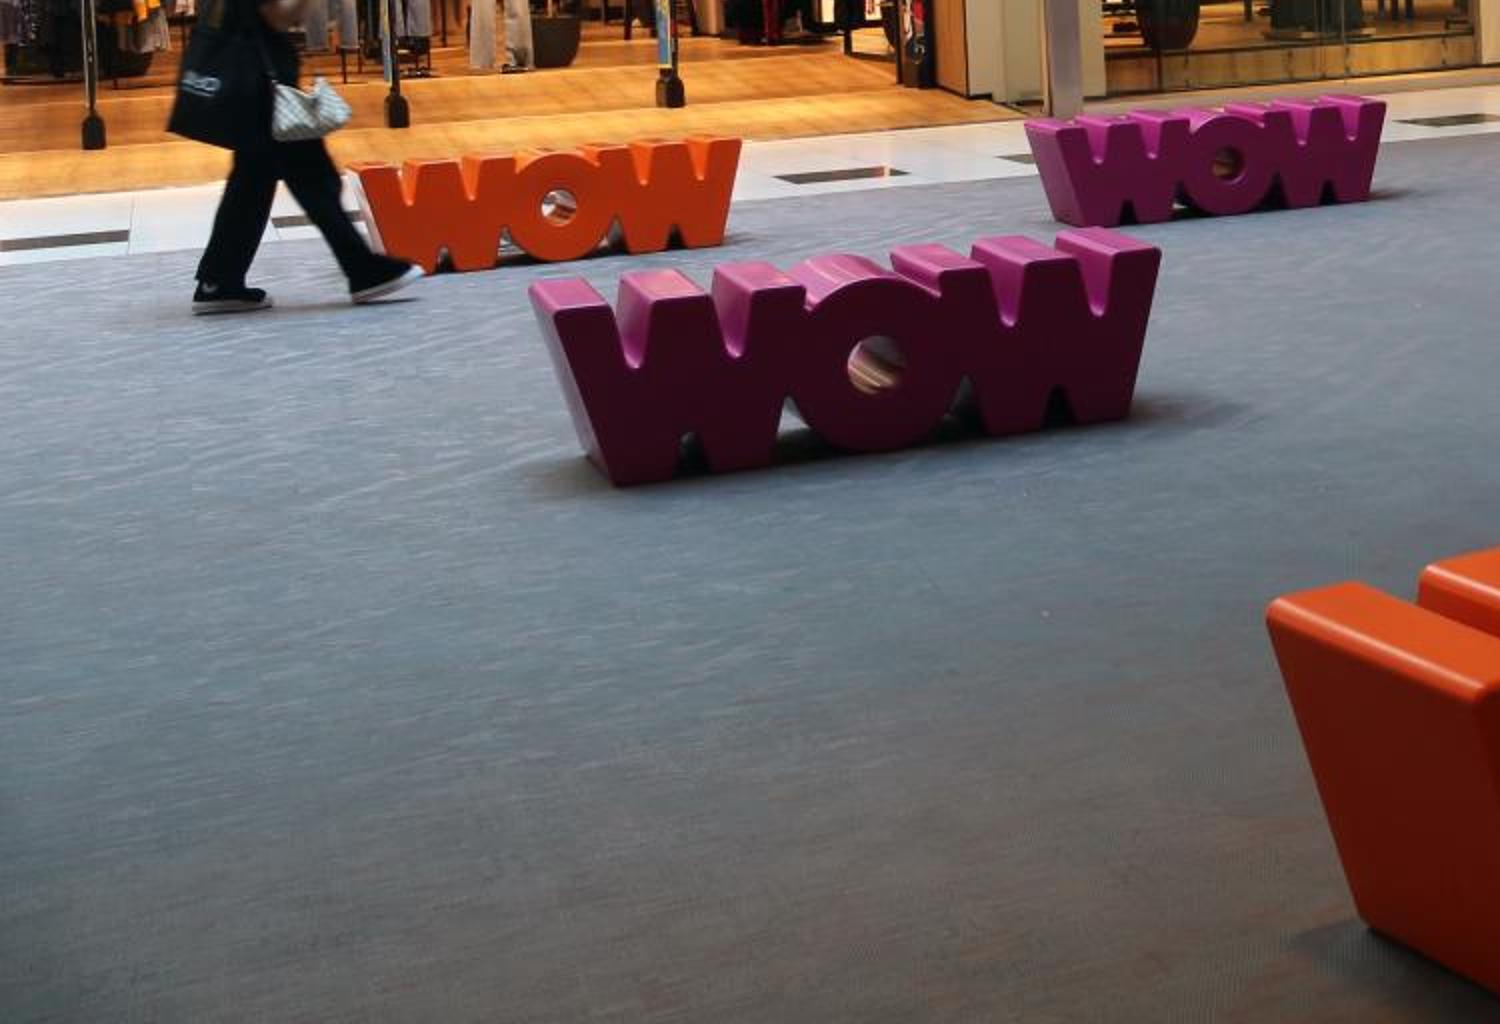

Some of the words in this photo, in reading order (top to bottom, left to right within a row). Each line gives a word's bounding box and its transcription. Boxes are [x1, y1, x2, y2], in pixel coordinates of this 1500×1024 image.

[352, 138, 743, 276] WOW
[1040, 97, 1387, 228] WOW
[540, 229, 1162, 487] WOW
